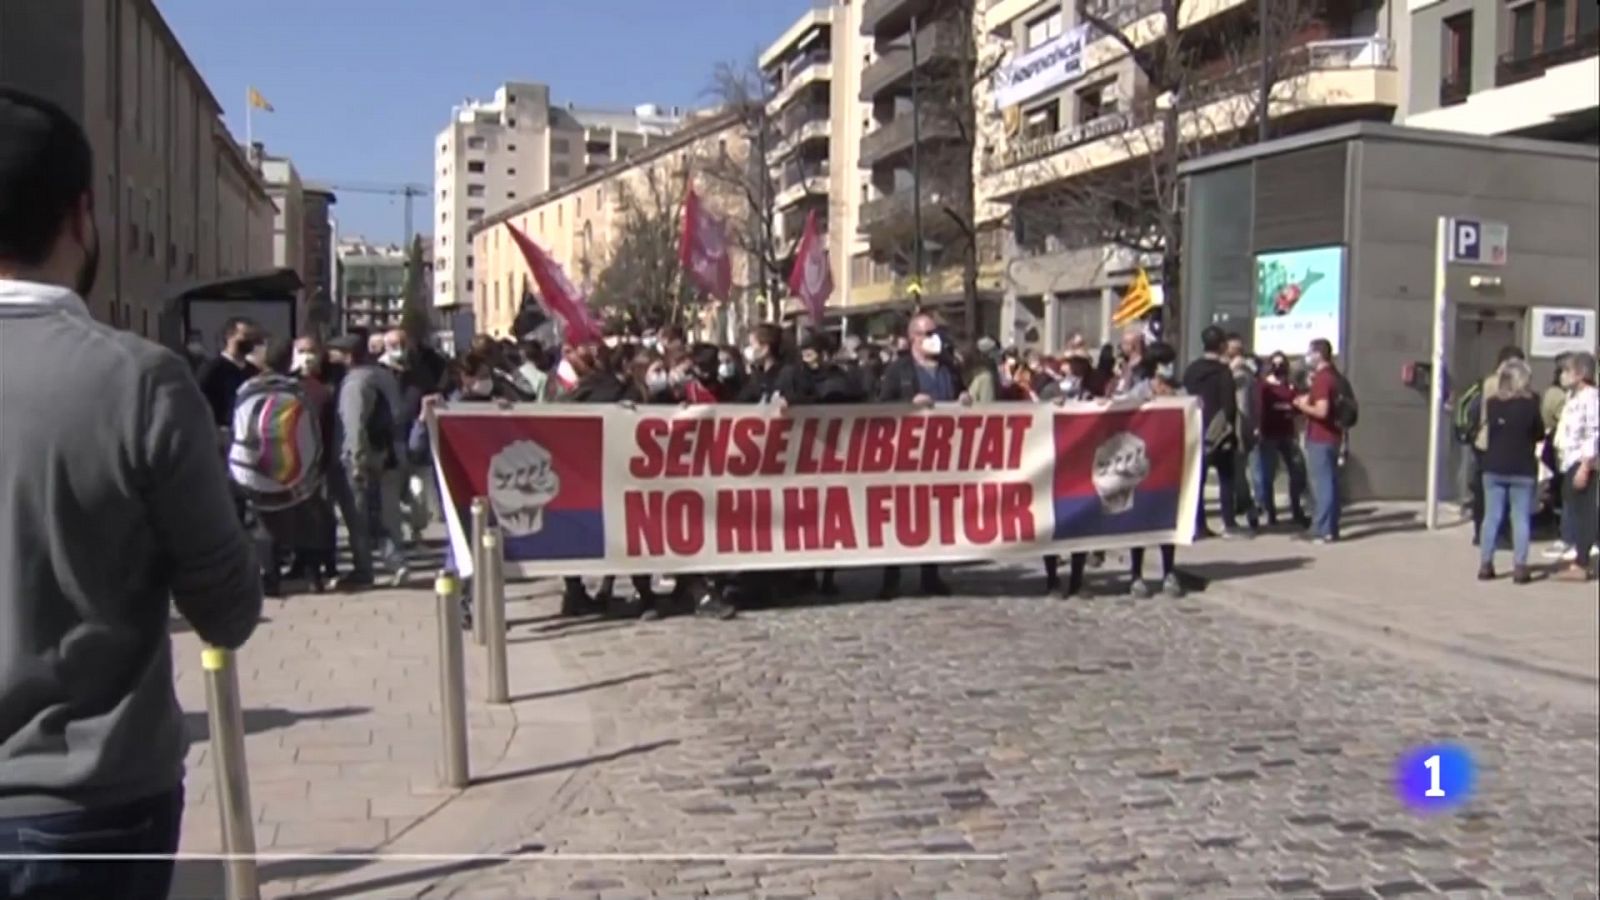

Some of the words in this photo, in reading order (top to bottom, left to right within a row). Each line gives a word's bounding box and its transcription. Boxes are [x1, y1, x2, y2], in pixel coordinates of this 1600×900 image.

[1458, 225, 1478, 256] P
[629, 417, 795, 479] SENSE
[796, 415, 1033, 475] LLIBERTAT
[624, 489, 706, 557] NO
[716, 488, 773, 554] HI
[783, 486, 858, 553] HA
[866, 482, 1036, 548] FUTUR
